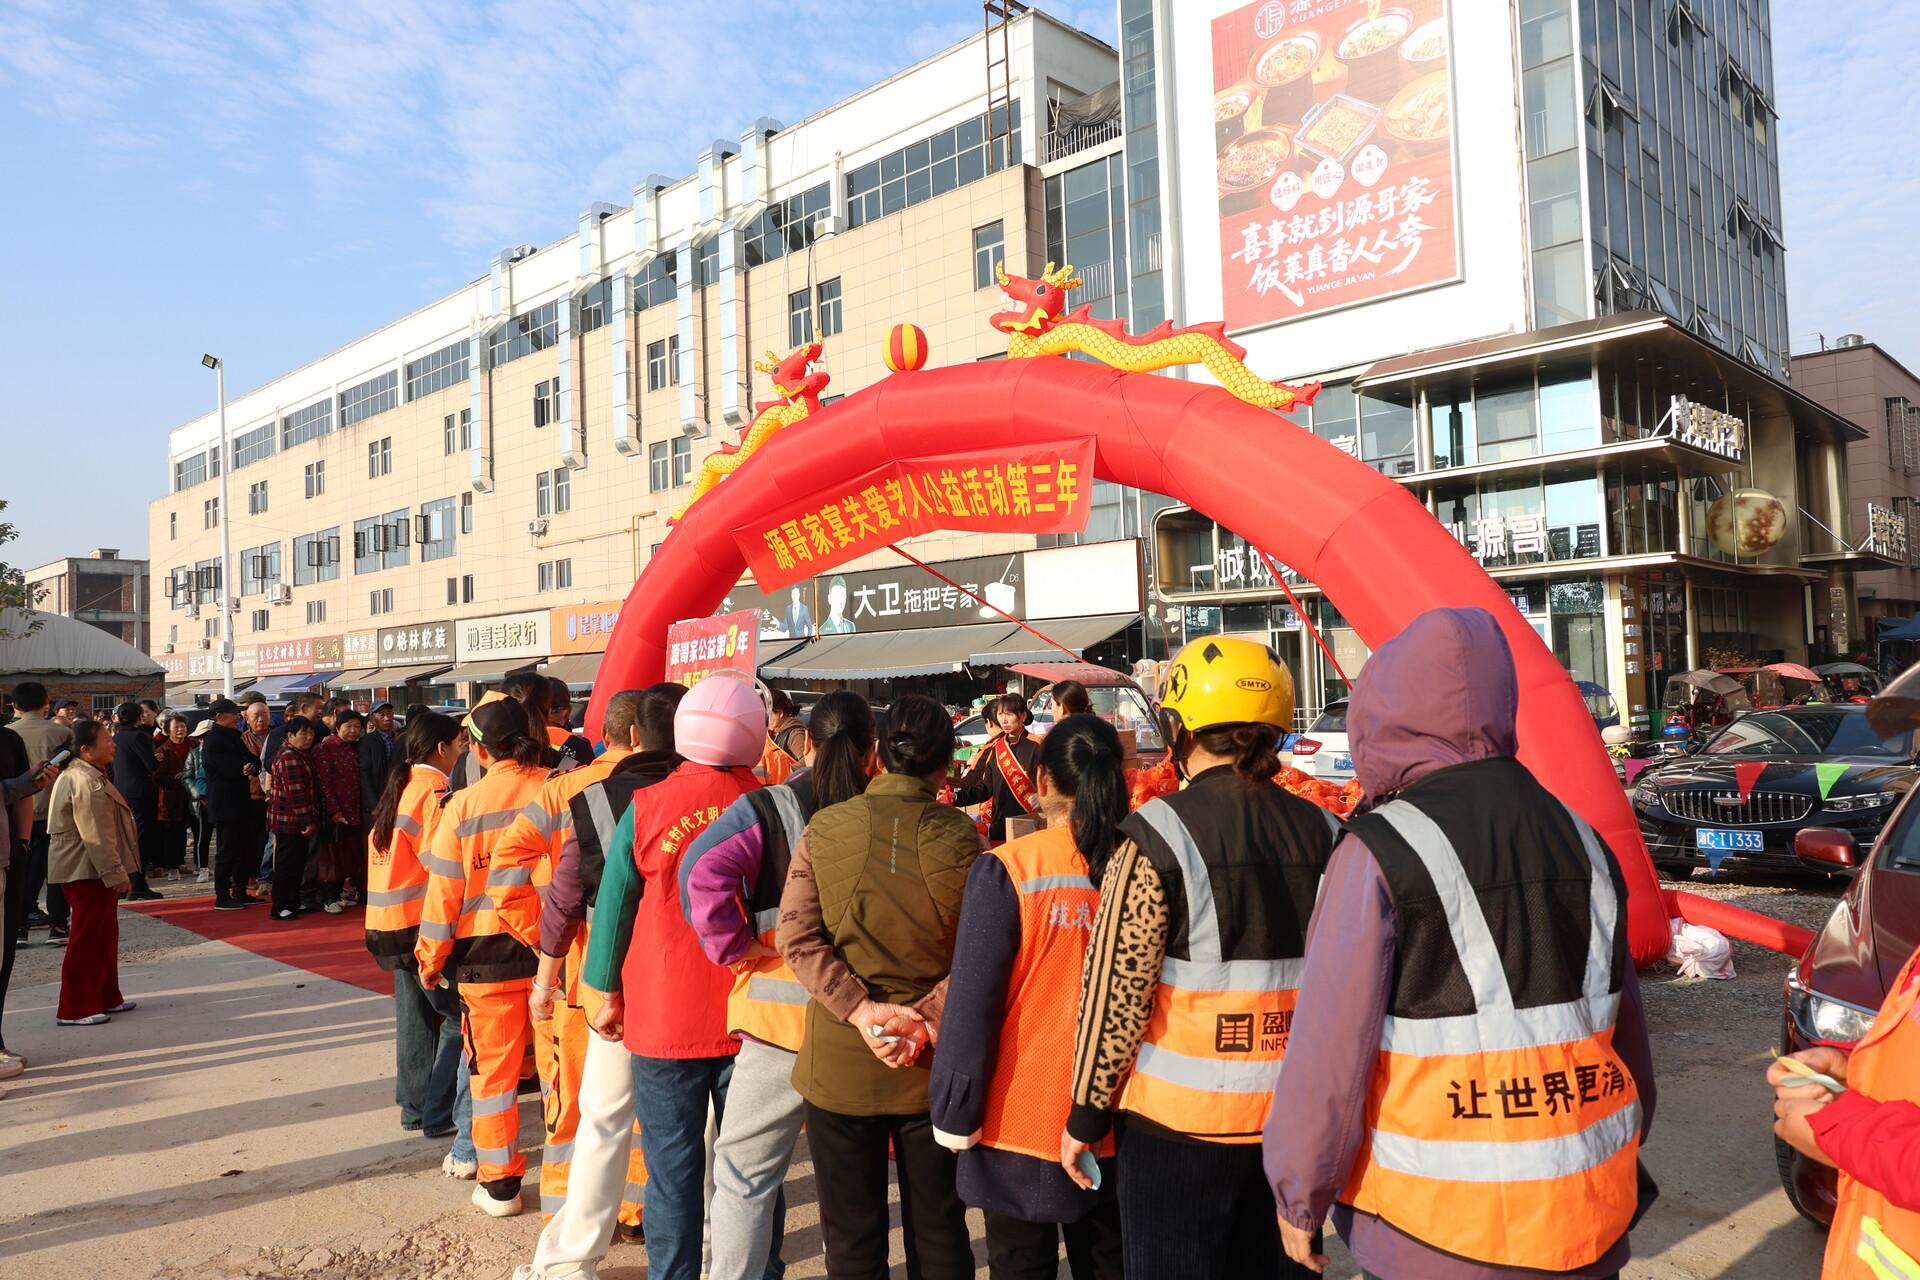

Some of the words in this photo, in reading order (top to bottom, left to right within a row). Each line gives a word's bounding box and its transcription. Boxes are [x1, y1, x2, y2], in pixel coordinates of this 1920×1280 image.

[1314, 171, 1342, 185] 用匠心
[1231, 176, 1441, 264] 喜事就到源哥家
[1245, 214, 1437, 307] 饭菜真香人人夸
[1307, 282, 1330, 294] YUAN
[1331, 279, 1343, 288] GE
[1344, 276, 1357, 286] JIA
[1357, 271, 1376, 282] YAN
[853, 582, 979, 619] 大卫拖把专家
[397, 626, 447, 652] 格林软装
[670, 624, 749, 666] 源哥家公益第3年
[1240, 680, 1267, 690] SMTK
[660, 806, 729, 854] 新时代文明
[1447, 1060, 1634, 1119] 让世界更清
